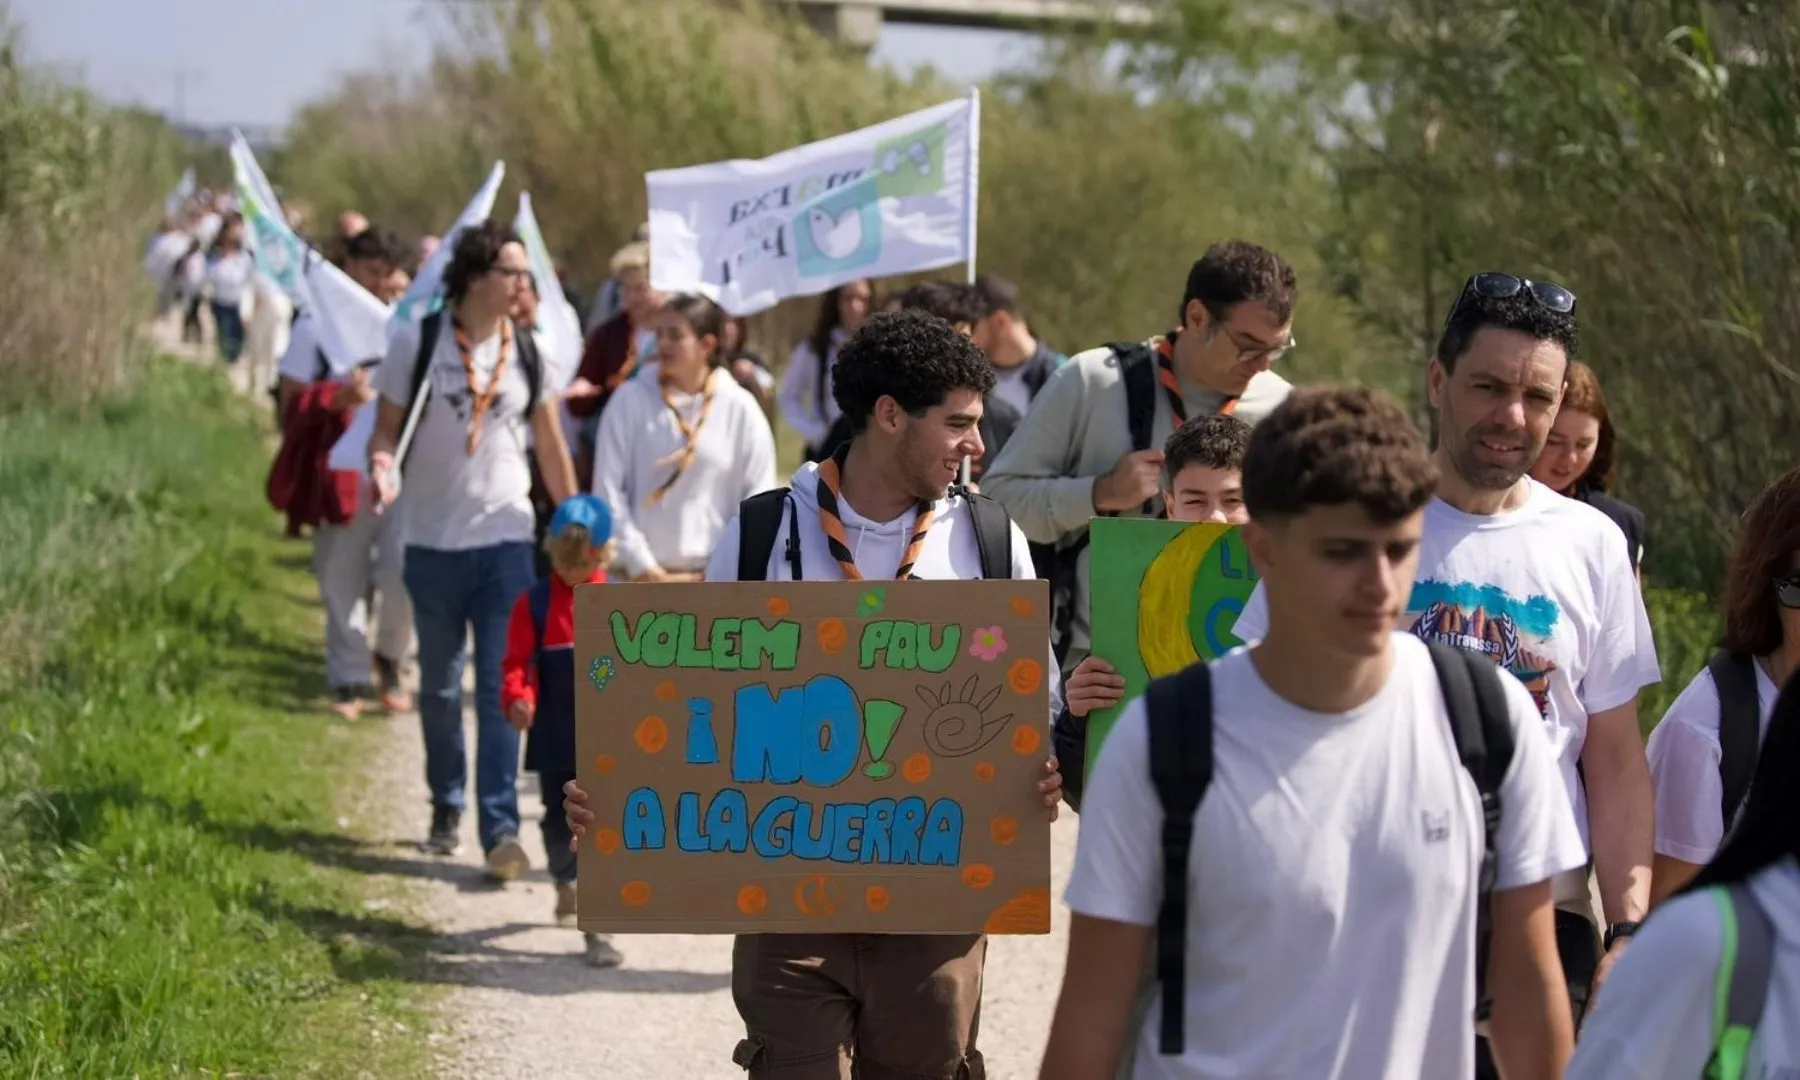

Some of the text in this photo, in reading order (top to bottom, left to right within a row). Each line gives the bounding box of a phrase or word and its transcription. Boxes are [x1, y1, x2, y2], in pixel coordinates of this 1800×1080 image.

[609, 609, 962, 673] VOLEM PAU
[622, 786, 964, 867] A LA GUERRA
